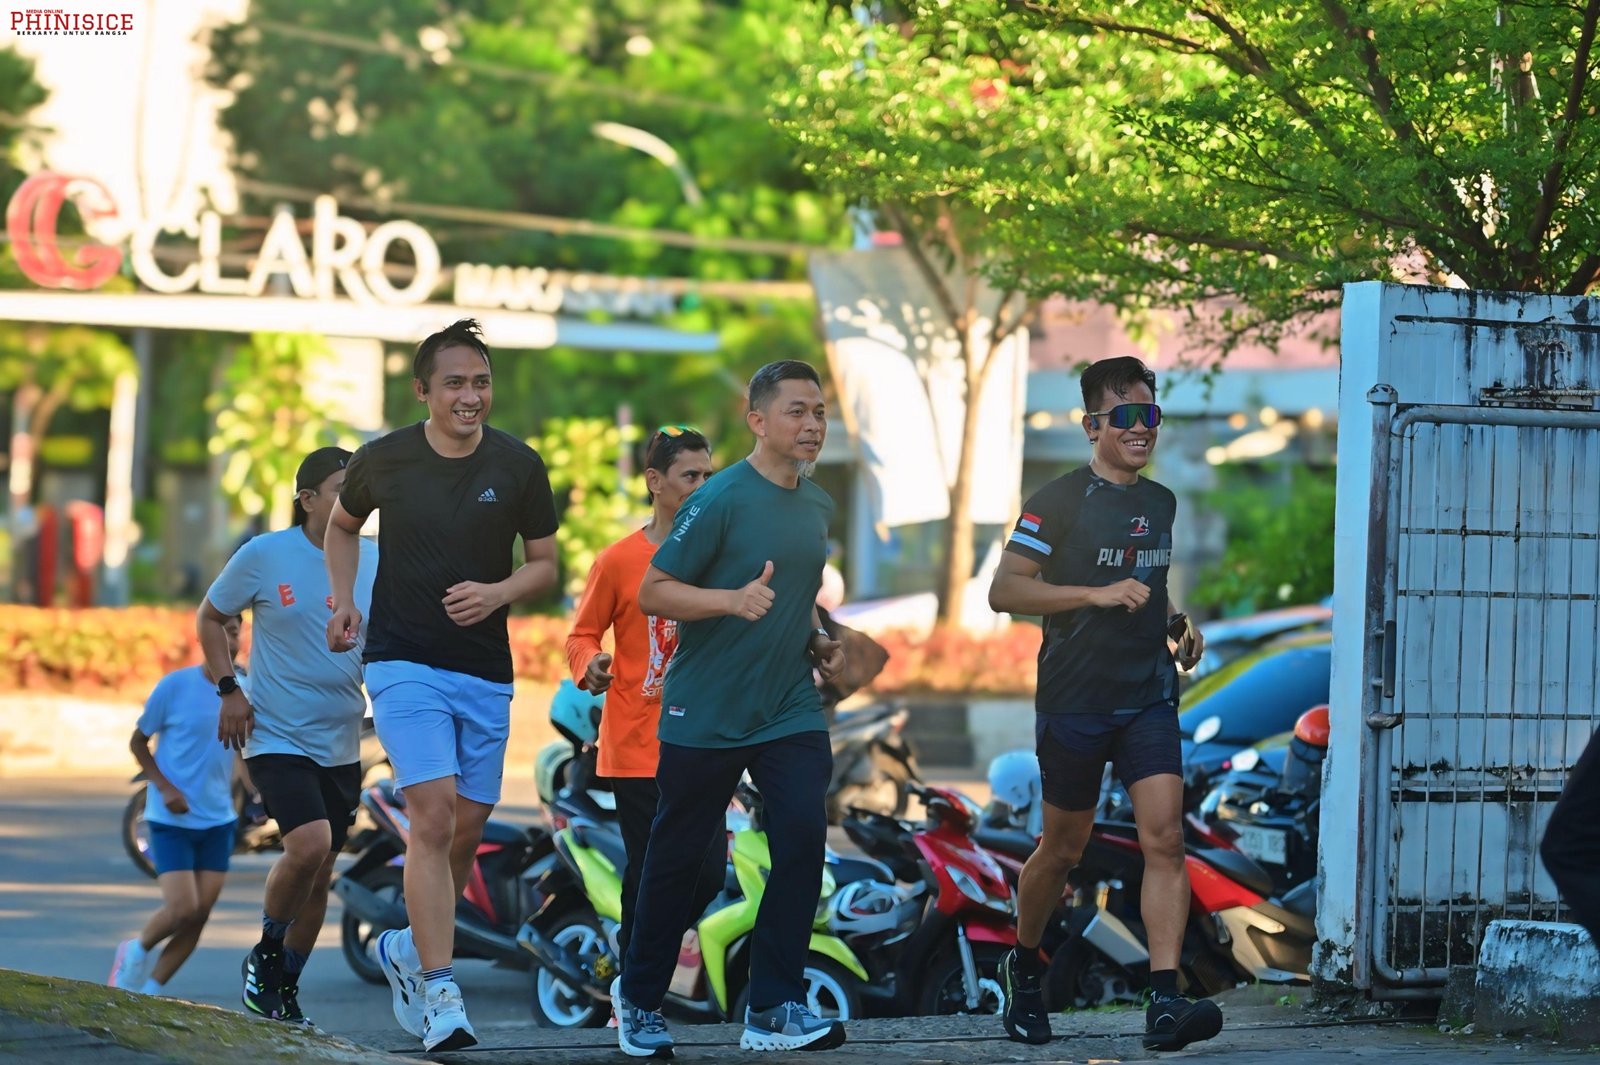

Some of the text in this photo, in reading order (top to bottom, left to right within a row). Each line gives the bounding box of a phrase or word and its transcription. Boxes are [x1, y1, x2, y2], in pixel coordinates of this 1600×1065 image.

[131, 194, 442, 305] CLARO
[673, 505, 701, 542] NIKE
[1097, 548, 1125, 567] PLN
